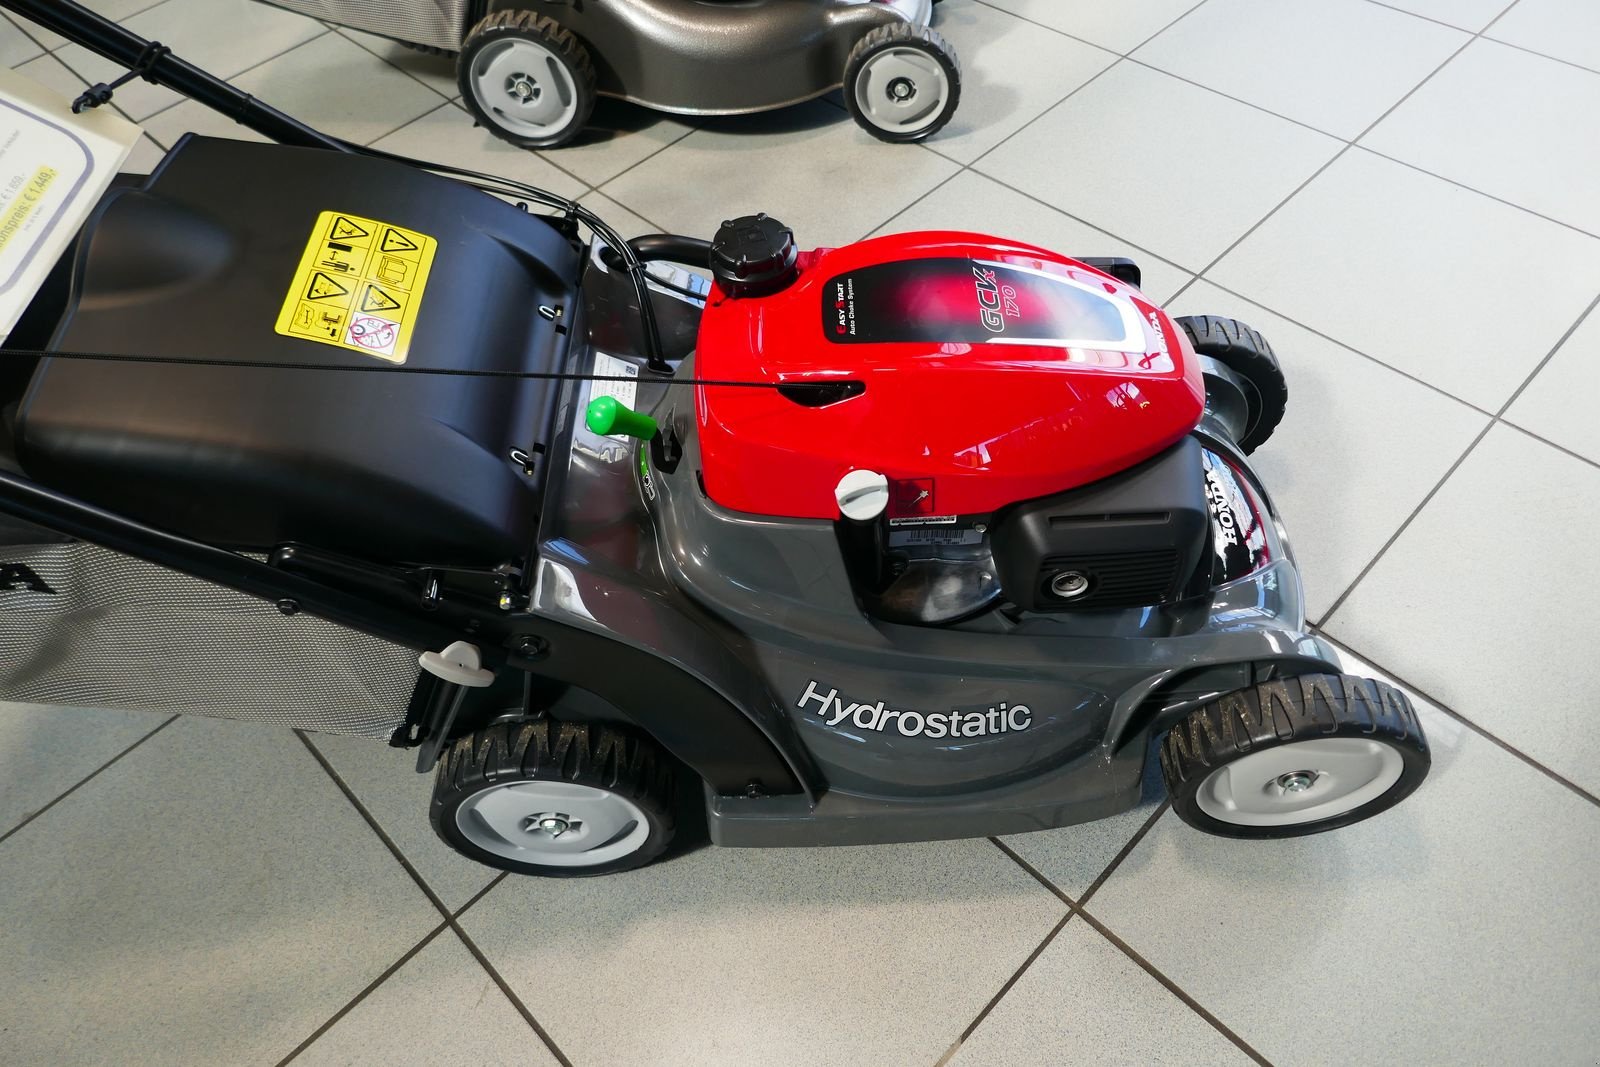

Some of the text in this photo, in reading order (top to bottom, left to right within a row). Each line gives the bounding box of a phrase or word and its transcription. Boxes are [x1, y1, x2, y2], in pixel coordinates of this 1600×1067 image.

[0, 202, 30, 247] onspreis:
[835, 282, 848, 335] EASY START
[847, 278, 855, 300] System
[1001, 285, 1020, 318] 170
[1206, 470, 1238, 547] HONDA
[796, 680, 1033, 739] Hydrostatic
